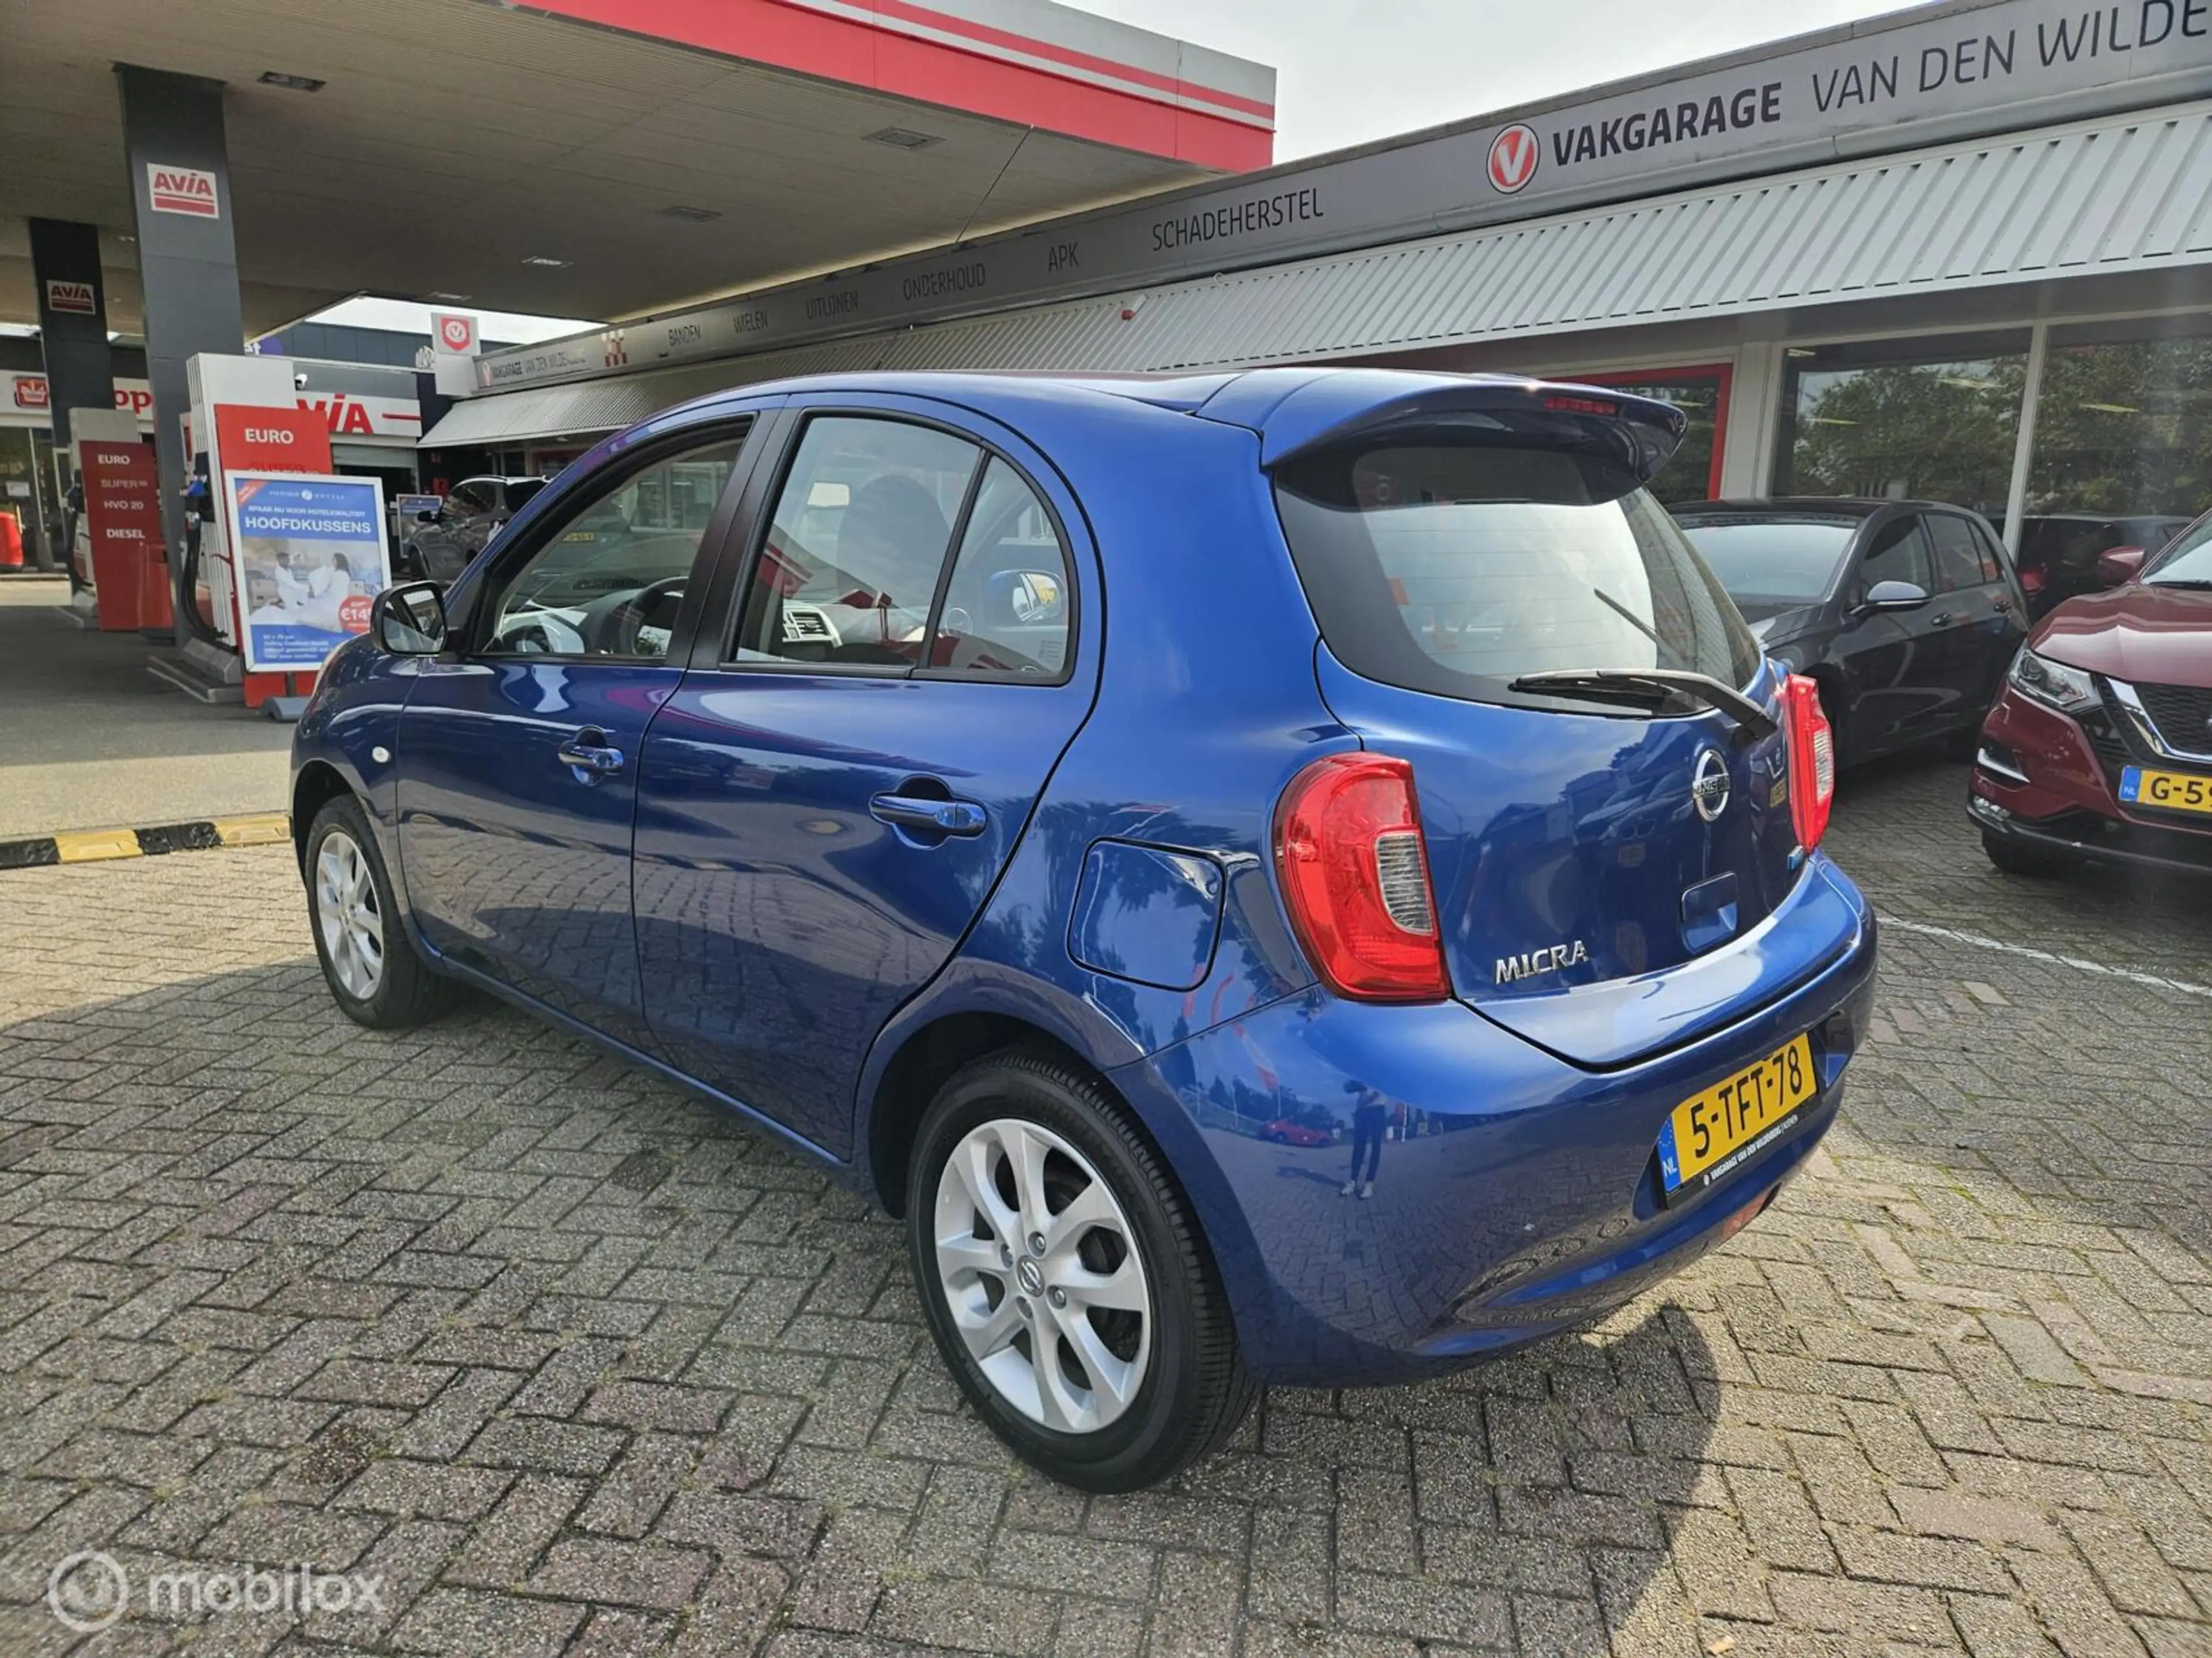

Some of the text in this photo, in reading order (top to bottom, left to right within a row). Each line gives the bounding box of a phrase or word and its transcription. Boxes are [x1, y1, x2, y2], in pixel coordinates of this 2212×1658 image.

[1553, 0, 2207, 166] VAKGARAGE VAN DEN WILDE
[154, 172, 213, 196] AVIA
[1153, 188, 1324, 251] SCHADEHERSTEL
[1048, 241, 1079, 273] APK
[903, 263, 986, 301] ONDERHOUD
[733, 310, 768, 333] WIELEN
[668, 324, 701, 346] BANDEN
[244, 428, 294, 444] EURO
[97, 454, 131, 465] EURO
[101, 479, 138, 488] SUPER
[104, 500, 144, 510] HVO 20
[106, 528, 145, 538] DIESEL
[245, 517, 372, 534] HOOFDKUSSENS
[2123, 786, 2136, 796] NL
[2151, 777, 2212, 807] G-5
[1495, 940, 1589, 985] MICRA
[1690, 1045, 1802, 1159] 5-TFT-78
[1662, 1156, 1678, 1179] NL
